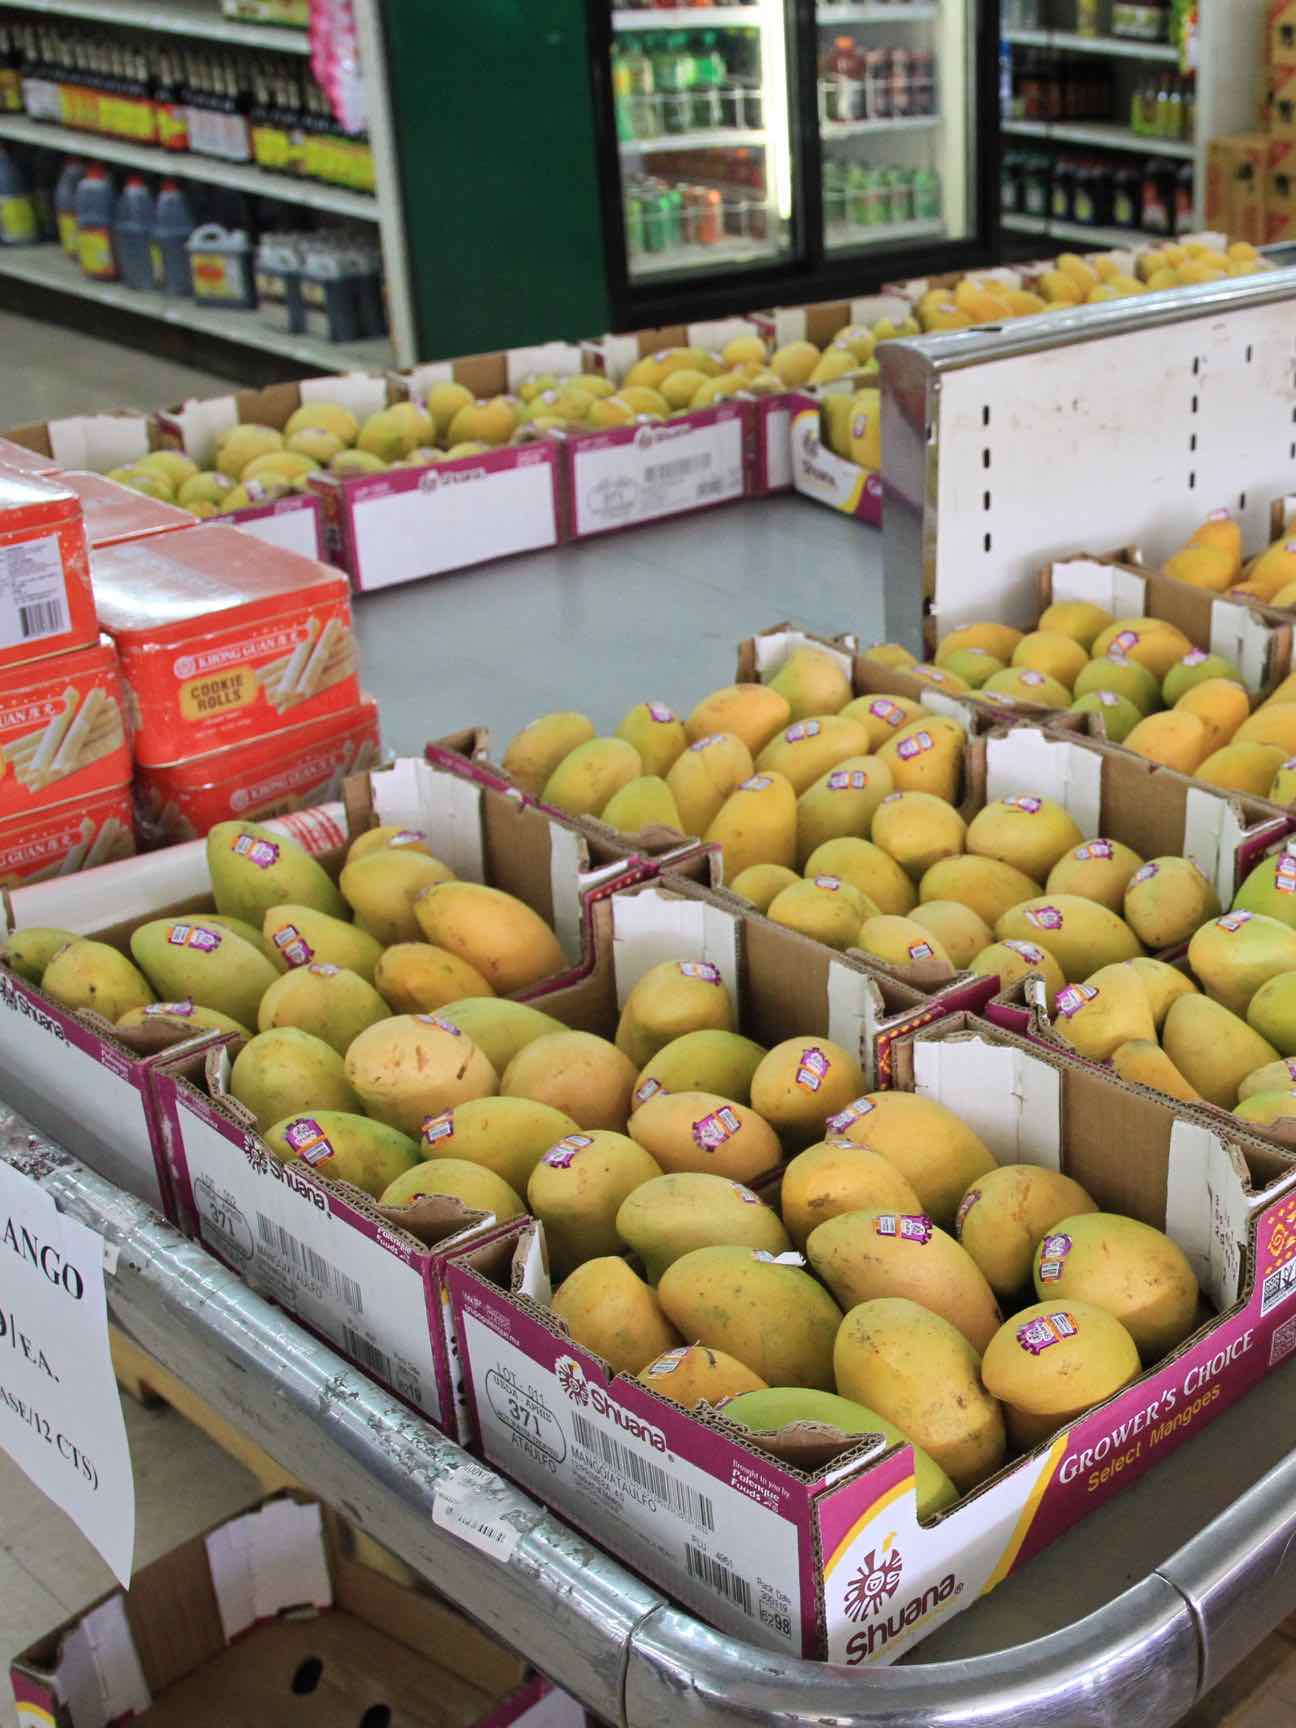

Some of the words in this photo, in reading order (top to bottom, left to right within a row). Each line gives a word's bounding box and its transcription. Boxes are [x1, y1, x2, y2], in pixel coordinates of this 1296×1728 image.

[191, 674, 243, 698] COOKIE
[197, 689, 242, 713] ROLLS
[508, 1398, 542, 1438] 371
[590, 1387, 666, 1453] Shuana
[1058, 1387, 1177, 1485] GROWER'S
[1182, 1327, 1255, 1396] CHOICE
[1087, 1440, 1143, 1493] Select
[1148, 1382, 1222, 1449] Mangoes
[846, 1573, 956, 1666] Shuana
